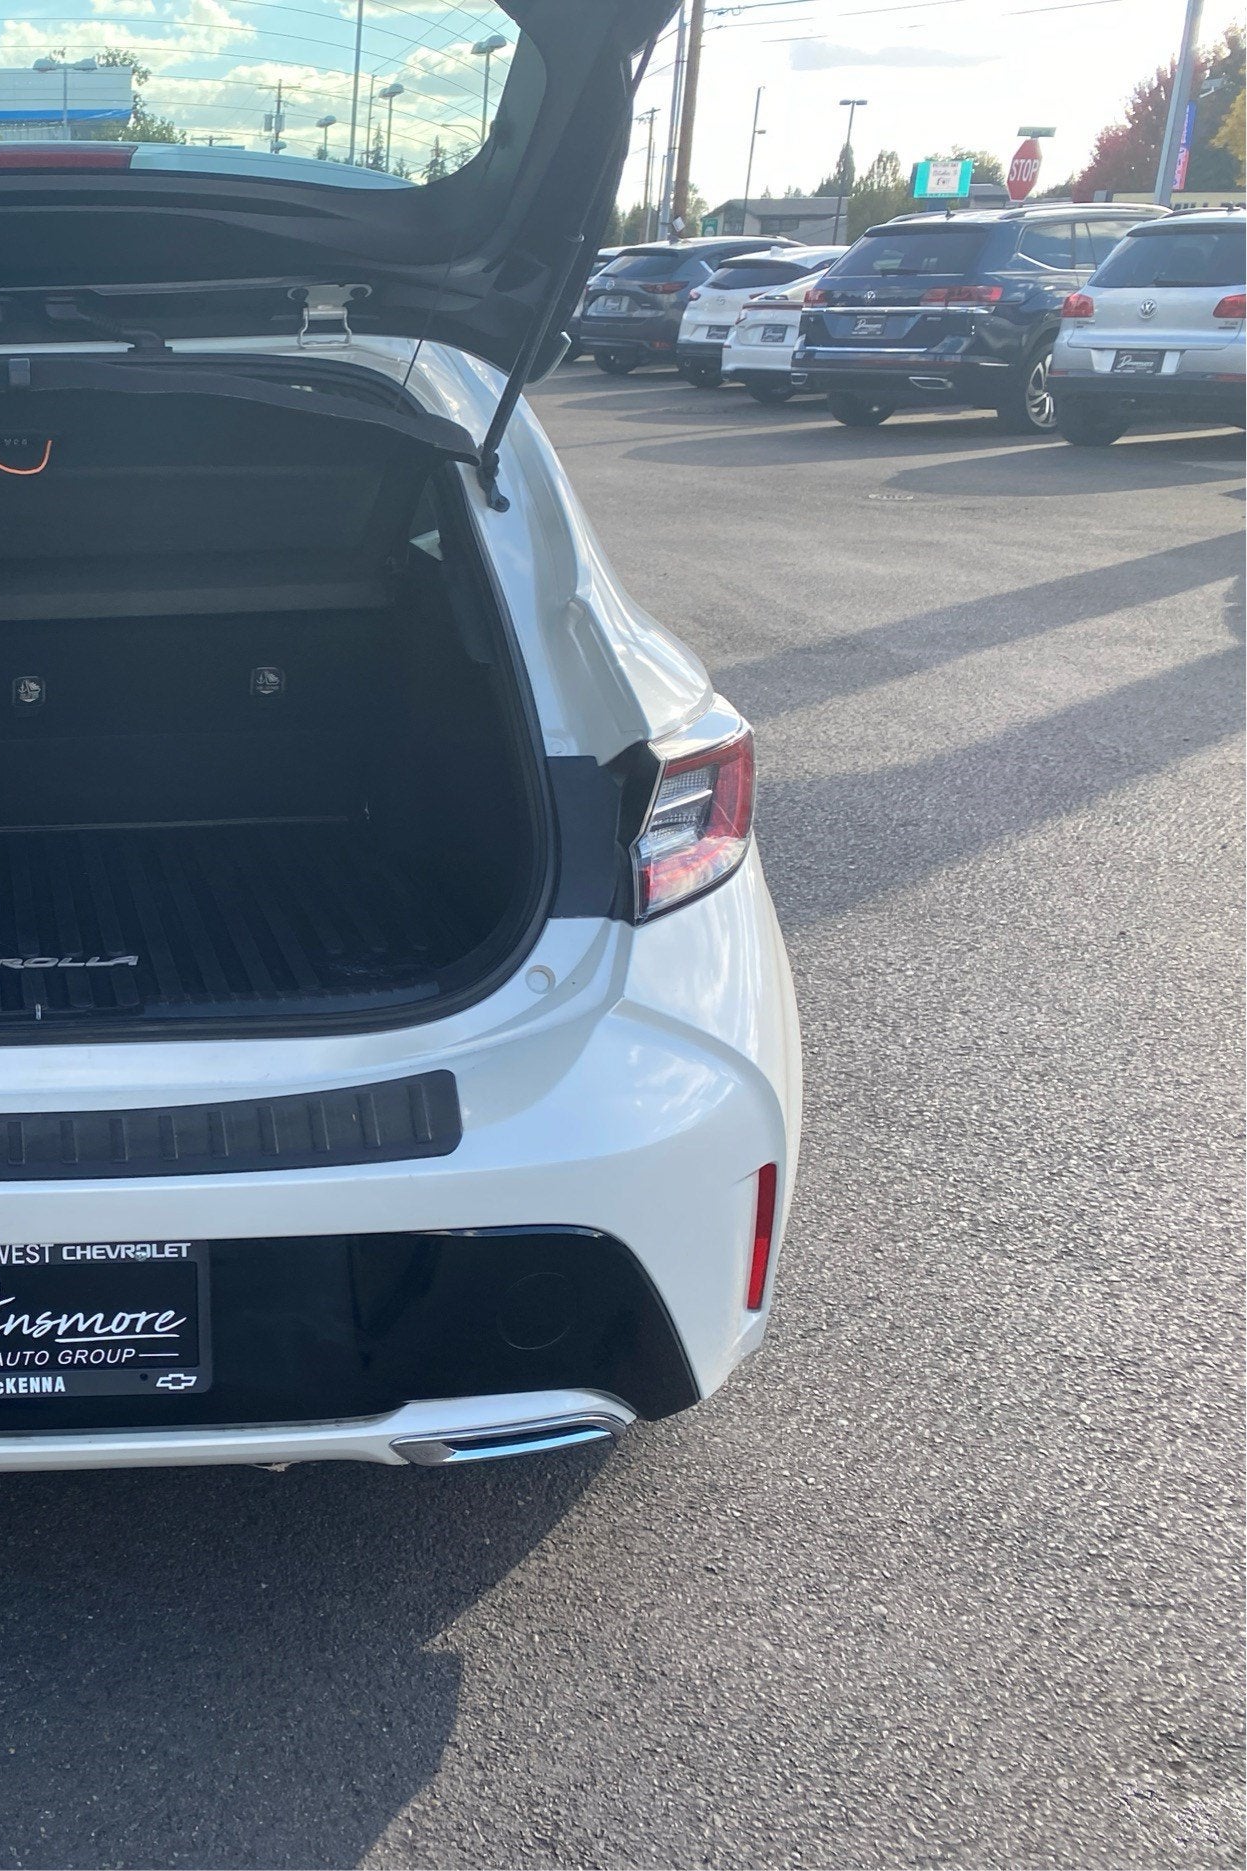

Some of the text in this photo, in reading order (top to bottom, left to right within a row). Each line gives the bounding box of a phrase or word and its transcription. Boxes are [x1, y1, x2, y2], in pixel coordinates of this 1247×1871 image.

[1009, 158, 1040, 182] STOP
[62, 1242, 192, 1260] CHEVROLET
[57, 1348, 136, 1365] GROUP
